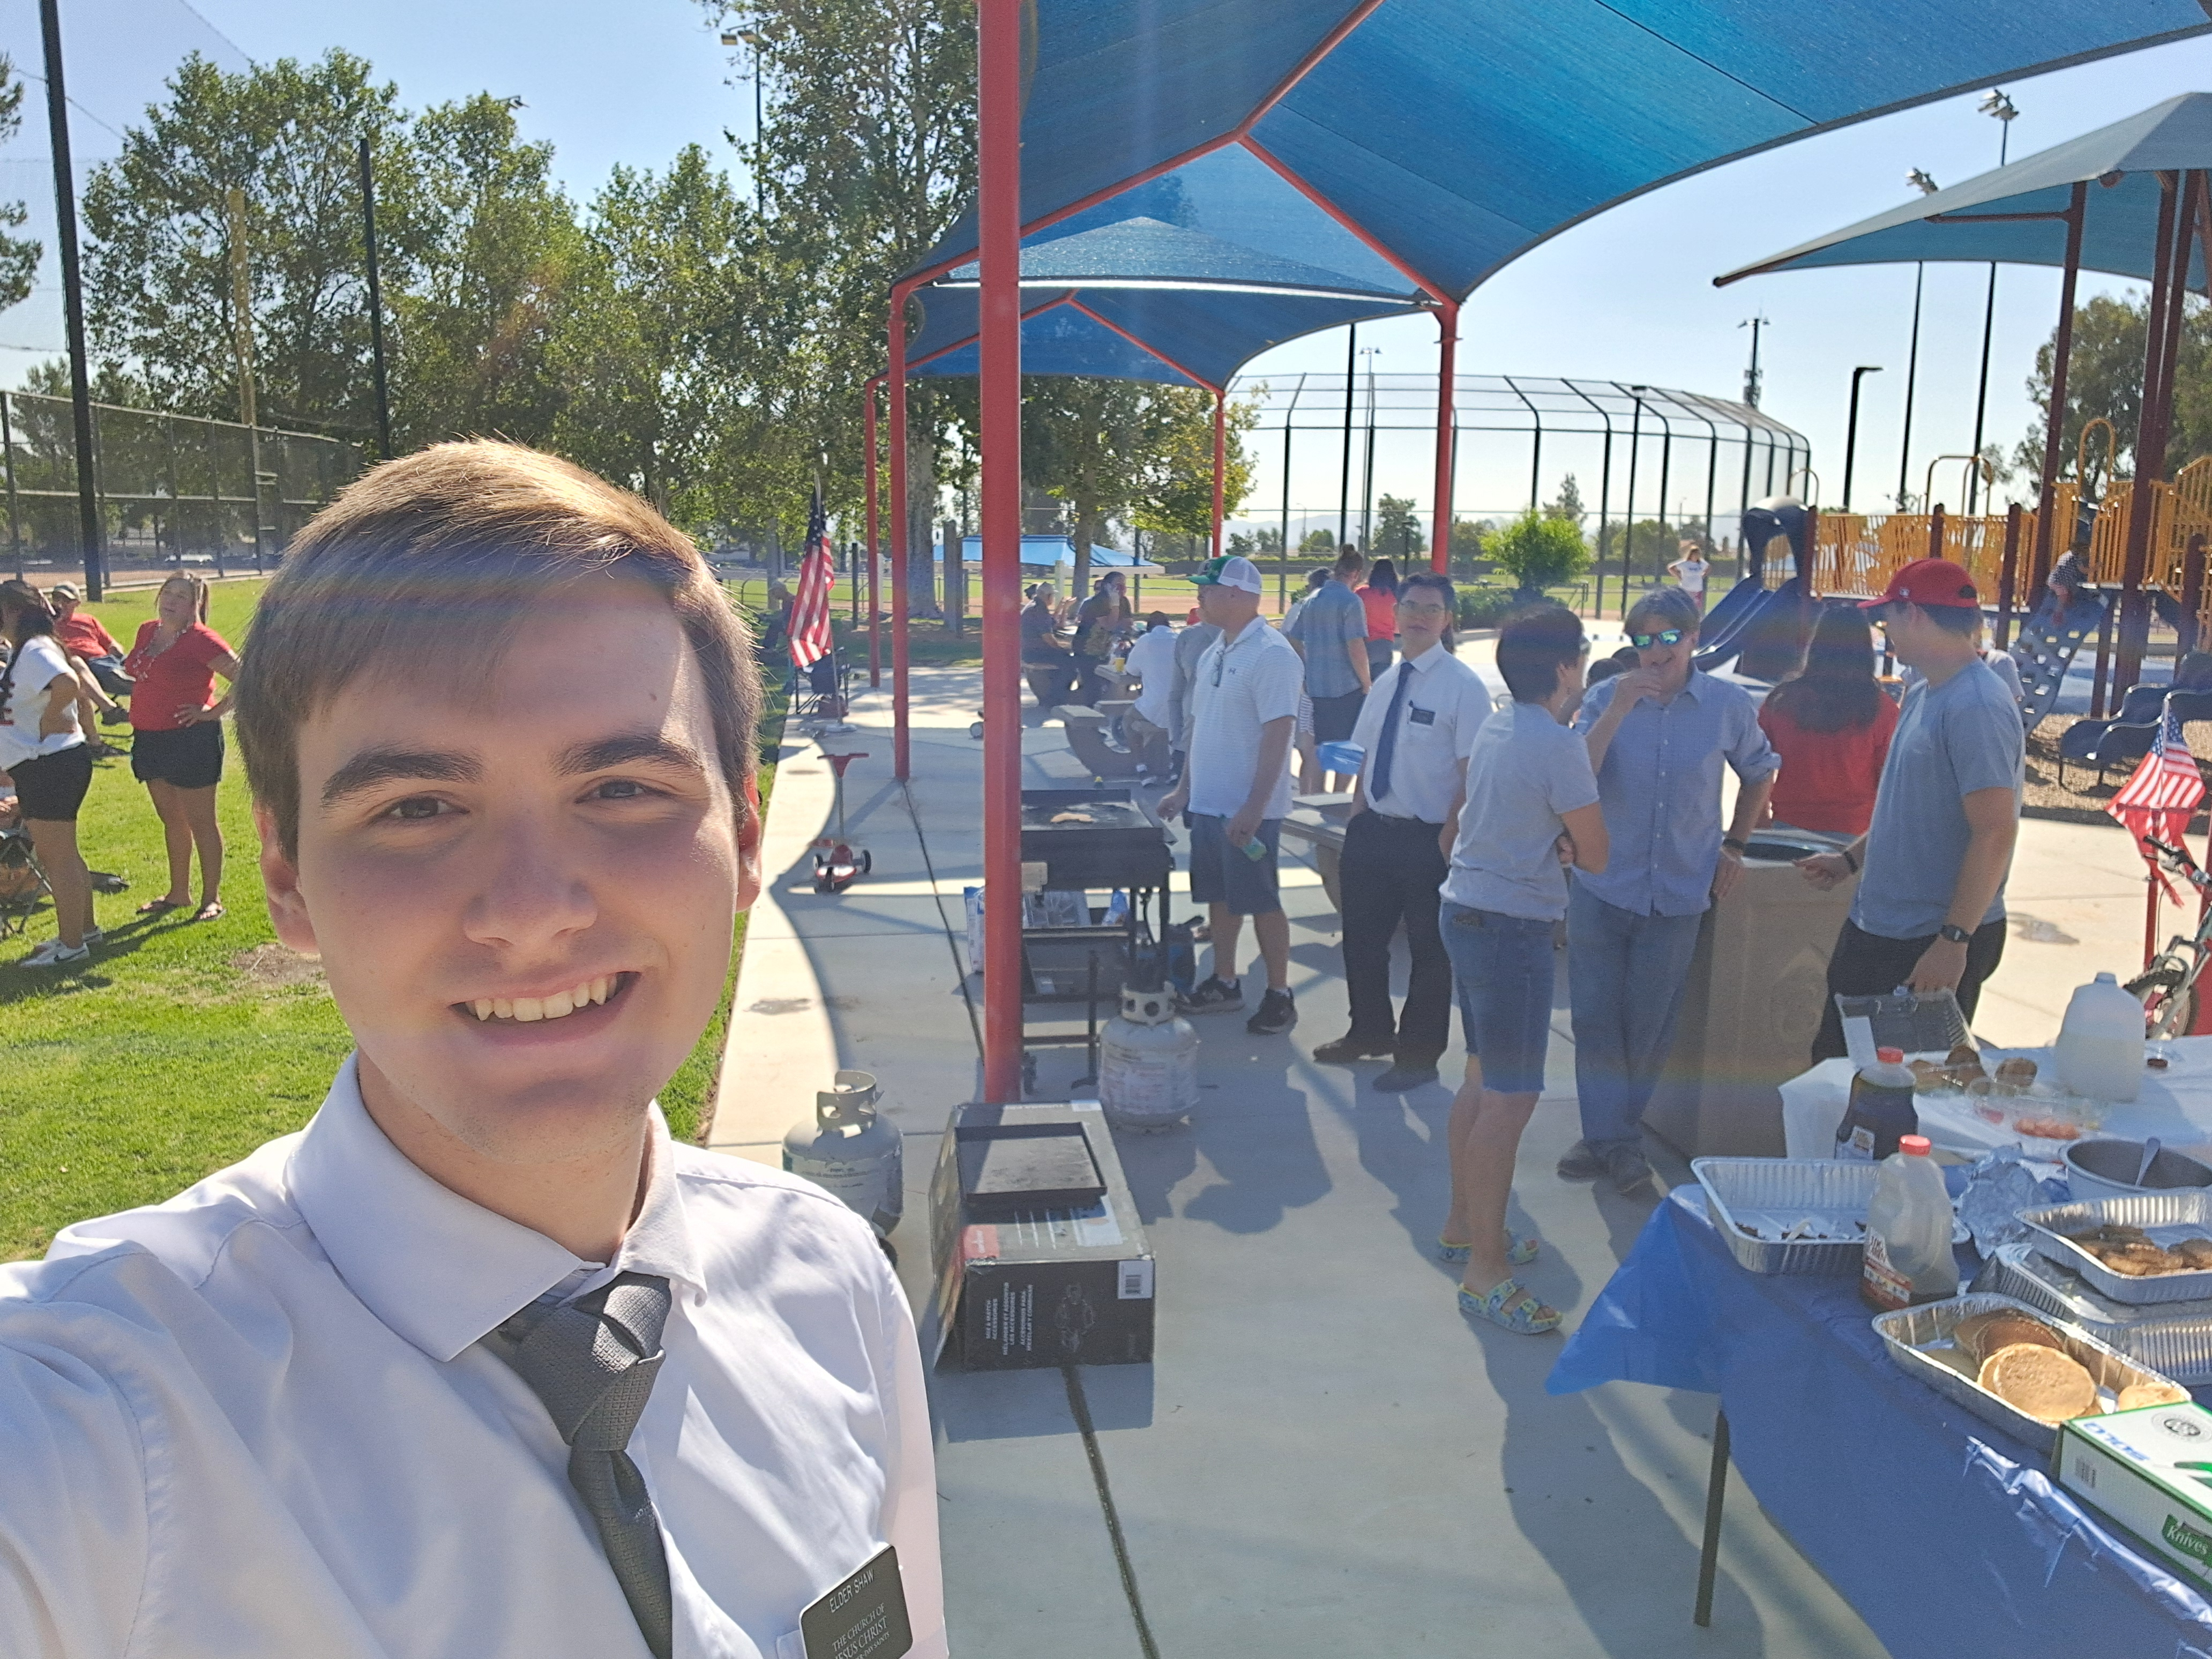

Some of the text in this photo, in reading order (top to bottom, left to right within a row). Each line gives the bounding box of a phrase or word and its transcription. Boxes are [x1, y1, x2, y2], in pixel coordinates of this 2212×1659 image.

[2166, 1525, 2208, 1555] Knives
[829, 1569, 874, 1613] ELDER SHAW
[832, 1603, 884, 1651] THE CHURCH OF
[835, 1615, 887, 1659] ESUS CHRIST
